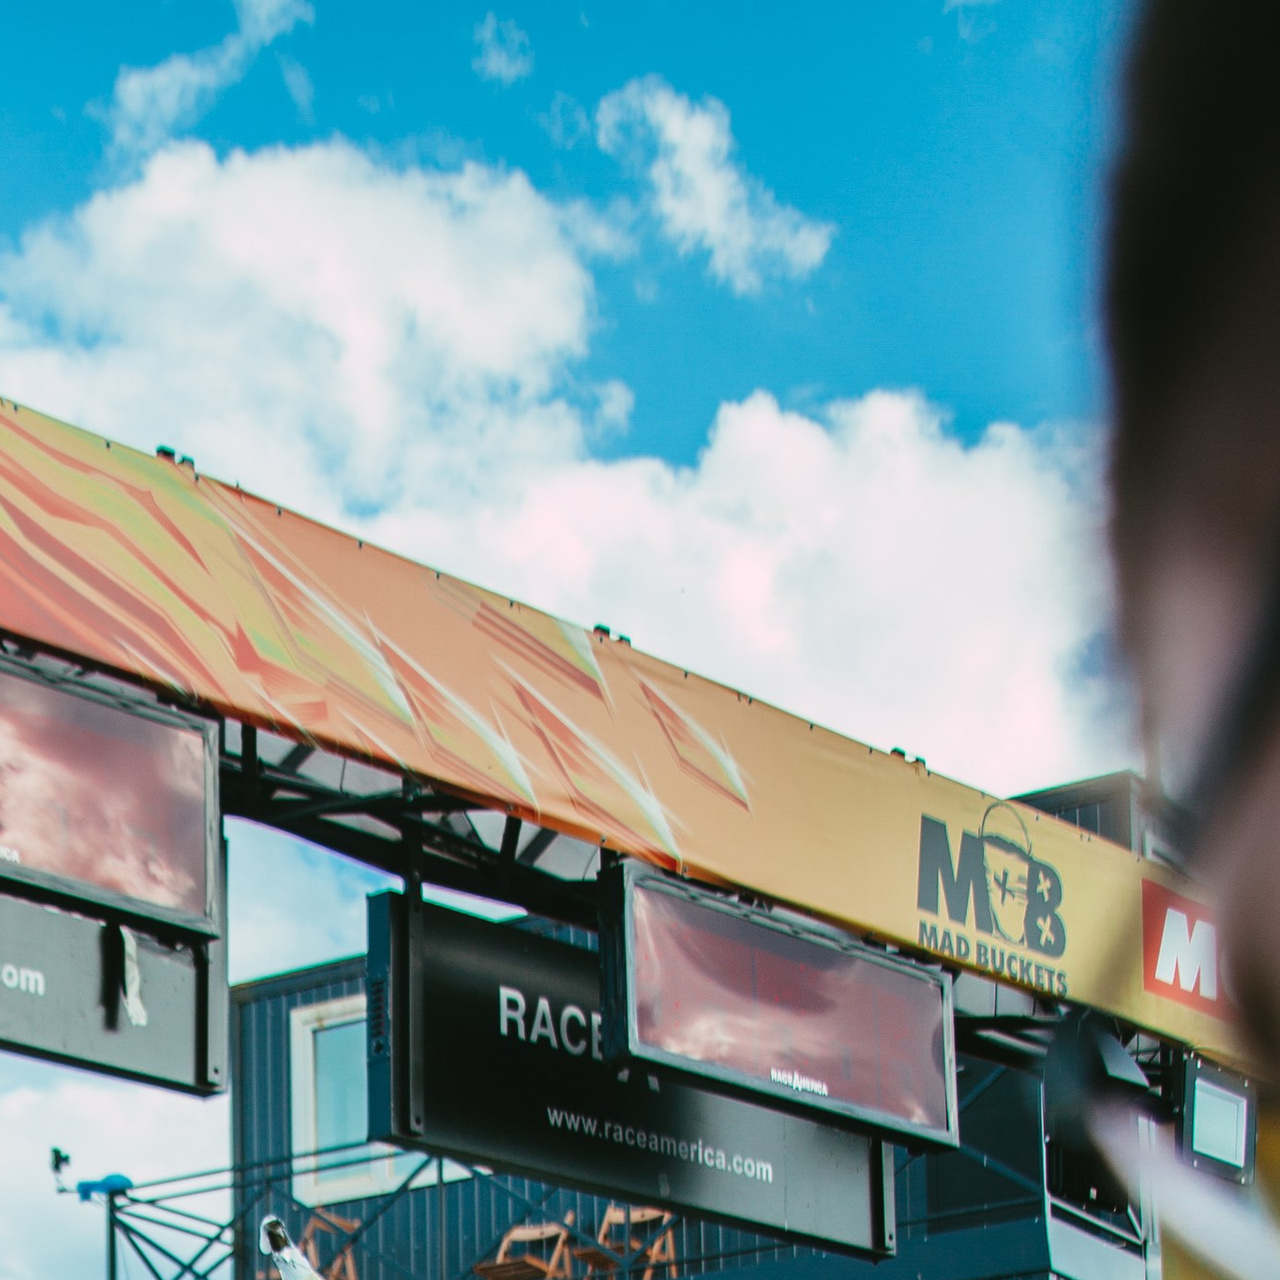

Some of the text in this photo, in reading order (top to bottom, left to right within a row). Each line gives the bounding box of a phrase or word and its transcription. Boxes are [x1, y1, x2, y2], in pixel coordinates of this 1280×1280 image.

[918, 919, 1068, 999] MAD BUCKETS
[546, 1105, 774, 1184] www.raceamerica.com
